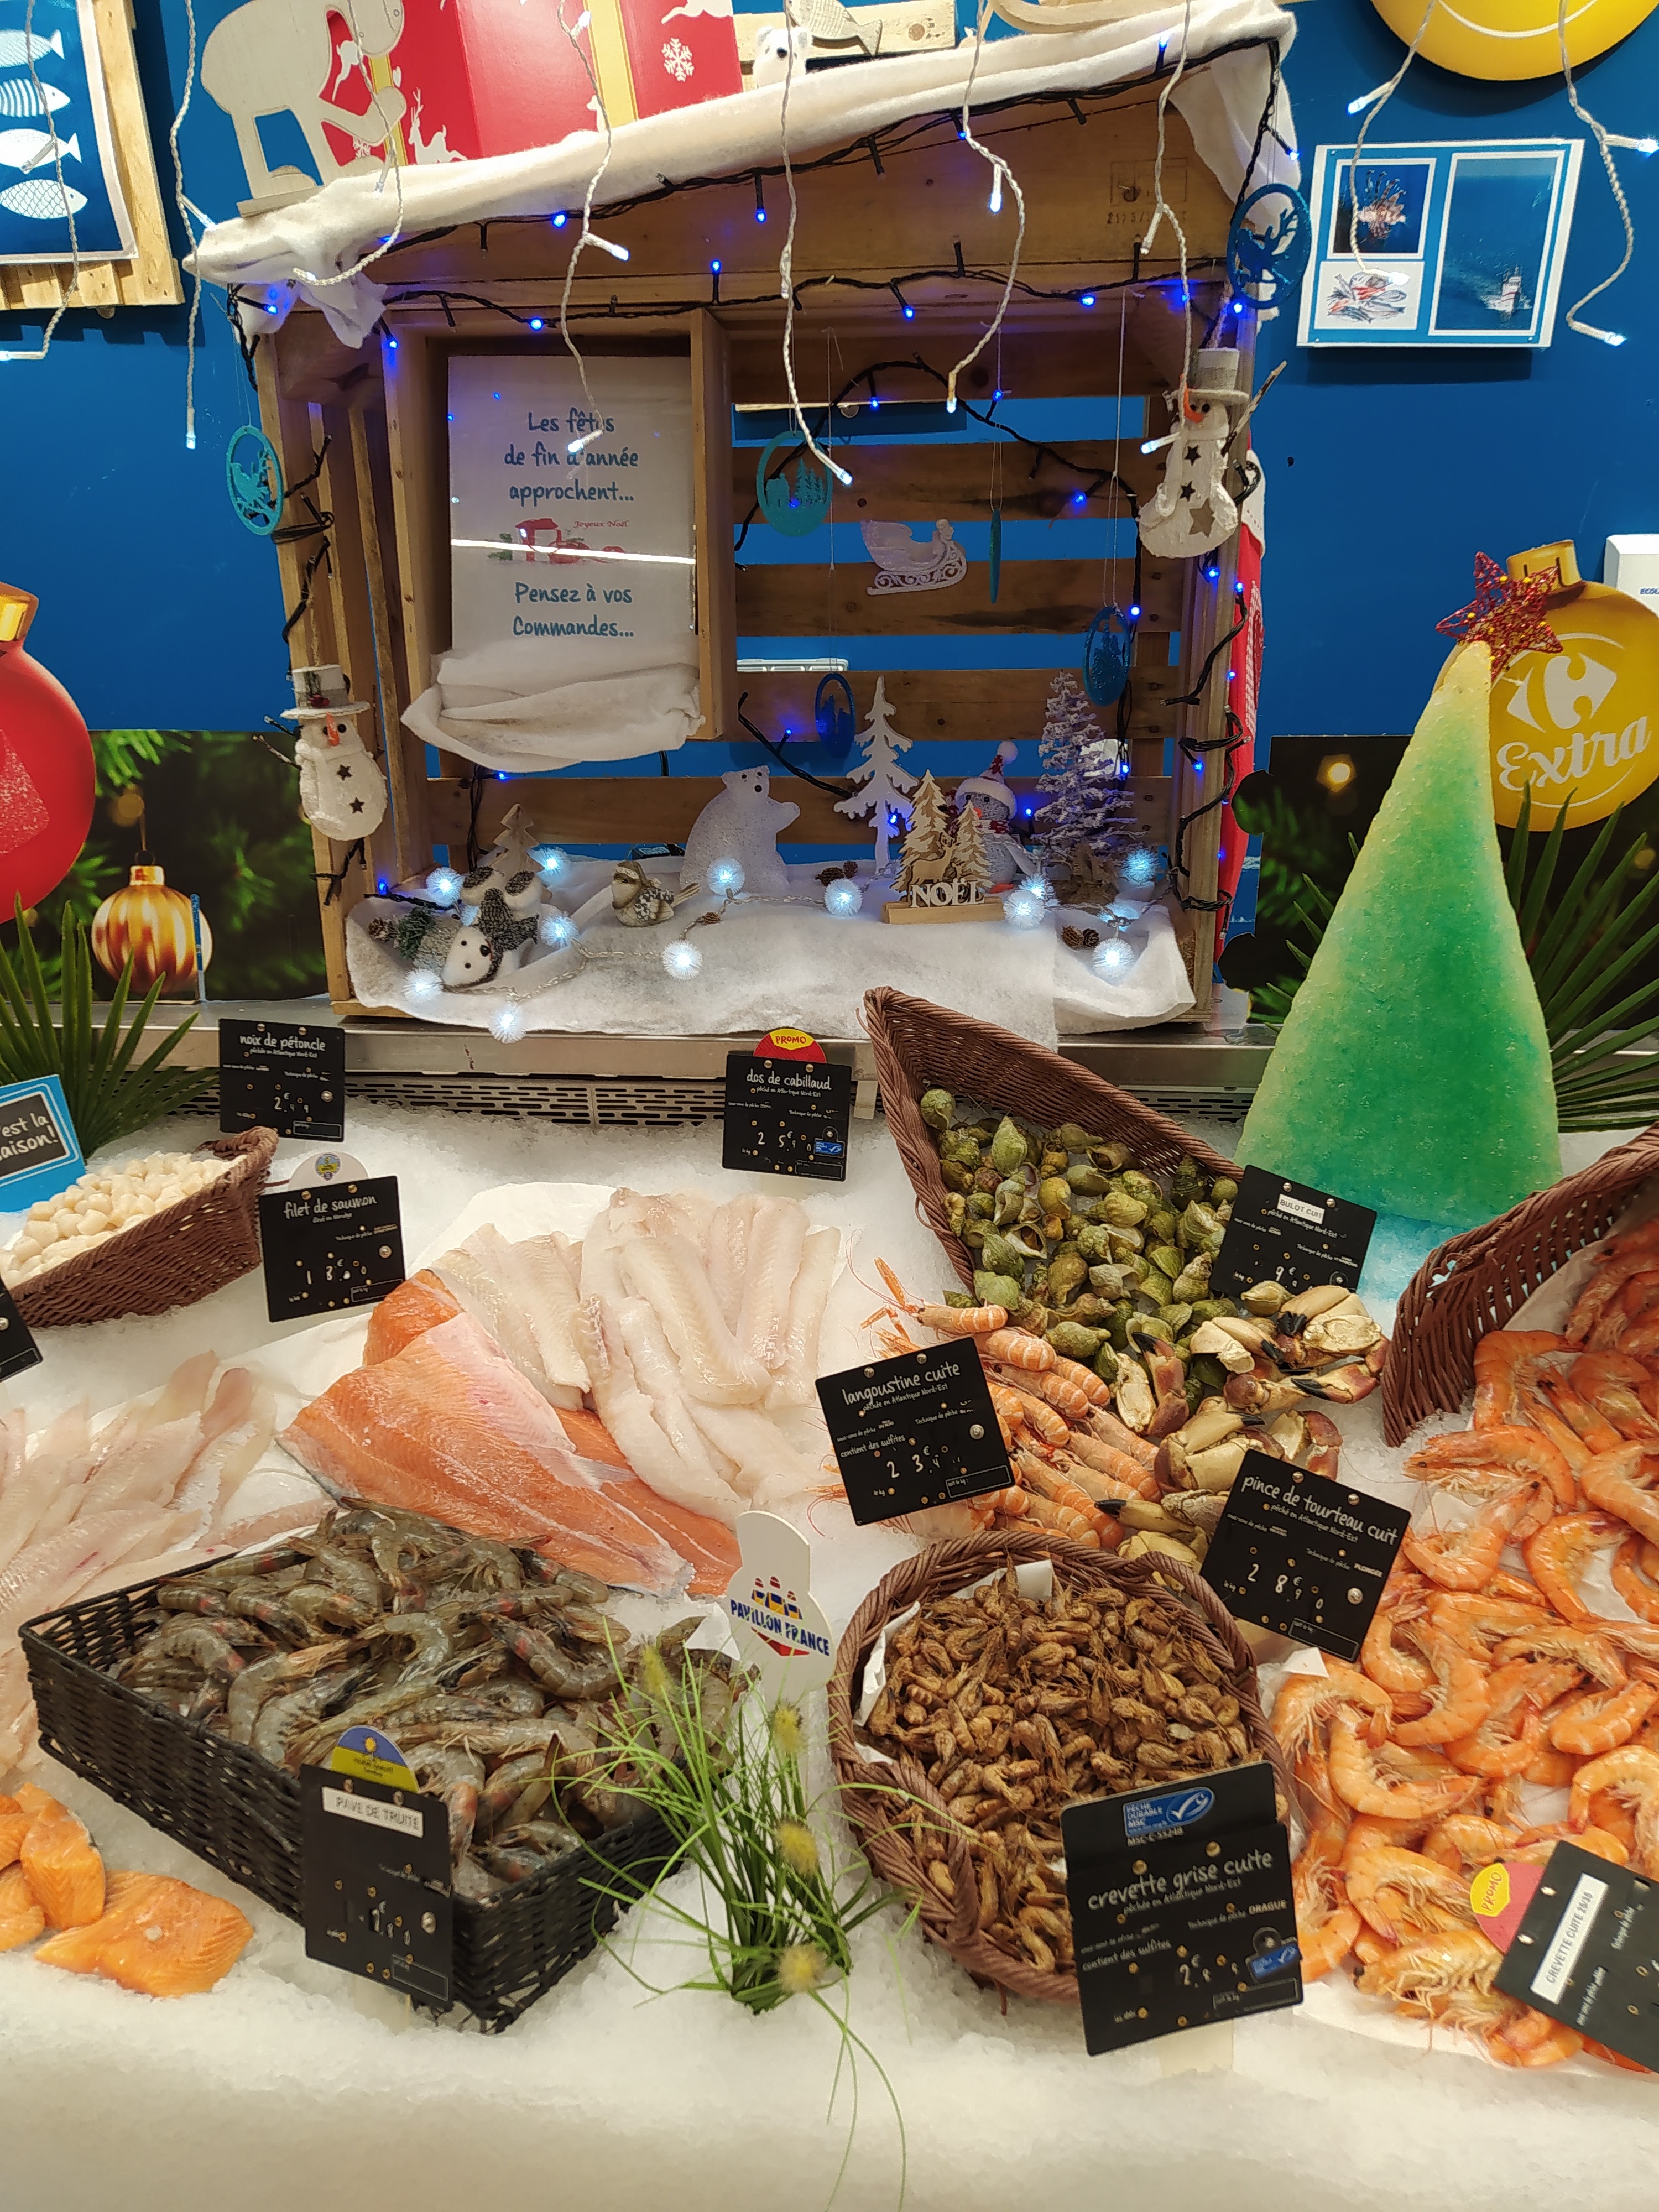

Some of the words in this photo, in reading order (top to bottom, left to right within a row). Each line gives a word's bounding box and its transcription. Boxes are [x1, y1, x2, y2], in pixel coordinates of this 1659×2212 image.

[528, 411, 559, 432] Les
[504, 444, 525, 466] de
[531, 441, 560, 467] fin
[509, 479, 634, 507] approchent...
[574, 520, 604, 529] Joyeux
[608, 519, 629, 528] Noël
[515, 582, 580, 604] Pensez
[586, 583, 596, 602] à
[604, 587, 633, 603] vos
[513, 614, 634, 637] Commandes...
[1496, 716, 1652, 791] Extra
[911, 877, 985, 908] NOËL
[239, 1034, 262, 1046] noix
[264, 1032, 277, 1047] de
[280, 1035, 326, 1051] pétoncle
[775, 1036, 807, 1044] PROMO
[747, 1068, 764, 1084] dos
[768, 1070, 780, 1086] de
[784, 1073, 832, 1091] cabillaud
[29, 1113, 50, 1128] la
[0, 1125, 59, 1161] aison!
[283, 1201, 310, 1219] filet
[313, 1198, 328, 1214] de
[1280, 1199, 1306, 1214] BULOT
[842, 1374, 921, 1405] langoustine
[924, 1360, 961, 1382] cuite
[863, 1402, 883, 1414] pêchée
[891, 1390, 921, 1405] Atlantique
[921, 1383, 948, 1397] Nord-Est
[914, 1413, 938, 1426] Technique
[943, 1410, 958, 1420] pêche
[840, 1443, 868, 1458] contient
[868, 1439, 880, 1451] des
[881, 1433, 906, 1448] sulfites
[1241, 1475, 1280, 1499] pince
[1282, 1485, 1300, 1507] de
[1303, 1494, 1364, 1533] tourteau
[1367, 1524, 1399, 1546] cuit
[730, 1599, 782, 1634] PAVILLON
[784, 1621, 831, 1657] FRANCE
[1127, 1806, 1163, 1820] DURABLE
[1128, 1818, 1146, 1828] MSC
[1088, 1874, 1167, 1910] crevette
[1173, 1863, 1218, 1893] grise
[1223, 1848, 1273, 1875] cuite
[1480, 1871, 1503, 1912] PROMO
[1248, 1899, 1287, 1915] DRAGUE
[1120, 1949, 1136, 1960] des
[1545, 1938, 1572, 1984] CREVETTE
[1567, 1915, 1584, 1939] CUITE
